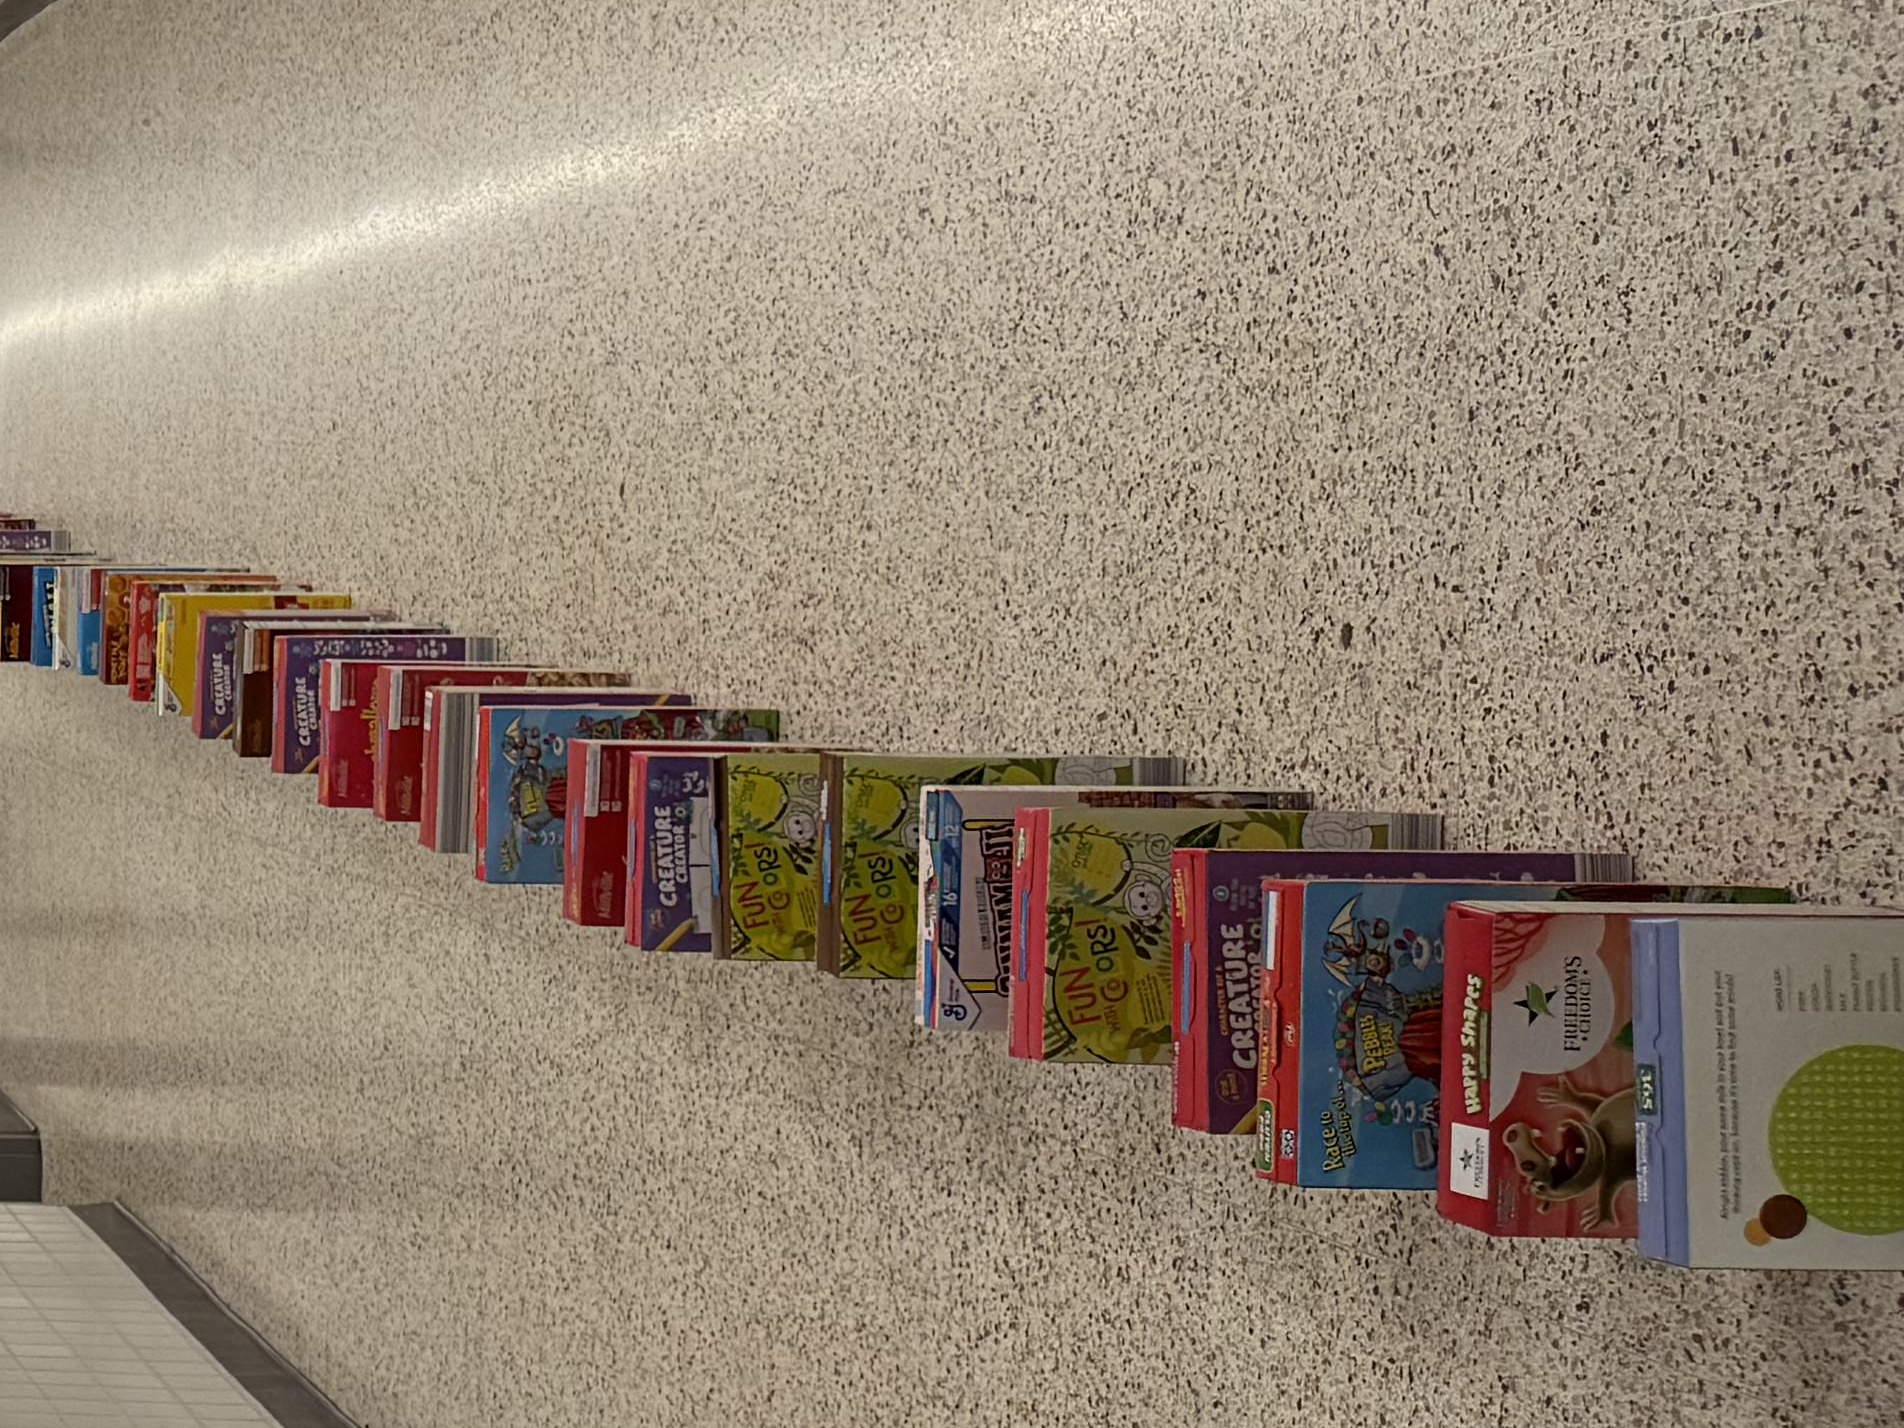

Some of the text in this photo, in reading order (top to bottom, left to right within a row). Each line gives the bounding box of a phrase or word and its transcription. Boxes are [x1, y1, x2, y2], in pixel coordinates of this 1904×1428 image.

[294, 676, 311, 746] CREATURE
[653, 805, 678, 907] CREATURE
[673, 825, 689, 884] CREATOR
[733, 880, 770, 929] FUN
[845, 894, 883, 945] FUN
[1059, 966, 1102, 1027] FUN
[1221, 923, 1257, 1069] CREATURE
[1562, 954, 1583, 1052] FREEDOM'S
[1579, 977, 1594, 1034] CHOICE
[1359, 1014, 1387, 1075] PEBBLES
[1320, 1110, 1346, 1172] Race to
[1335, 1109, 1357, 1157] the top
